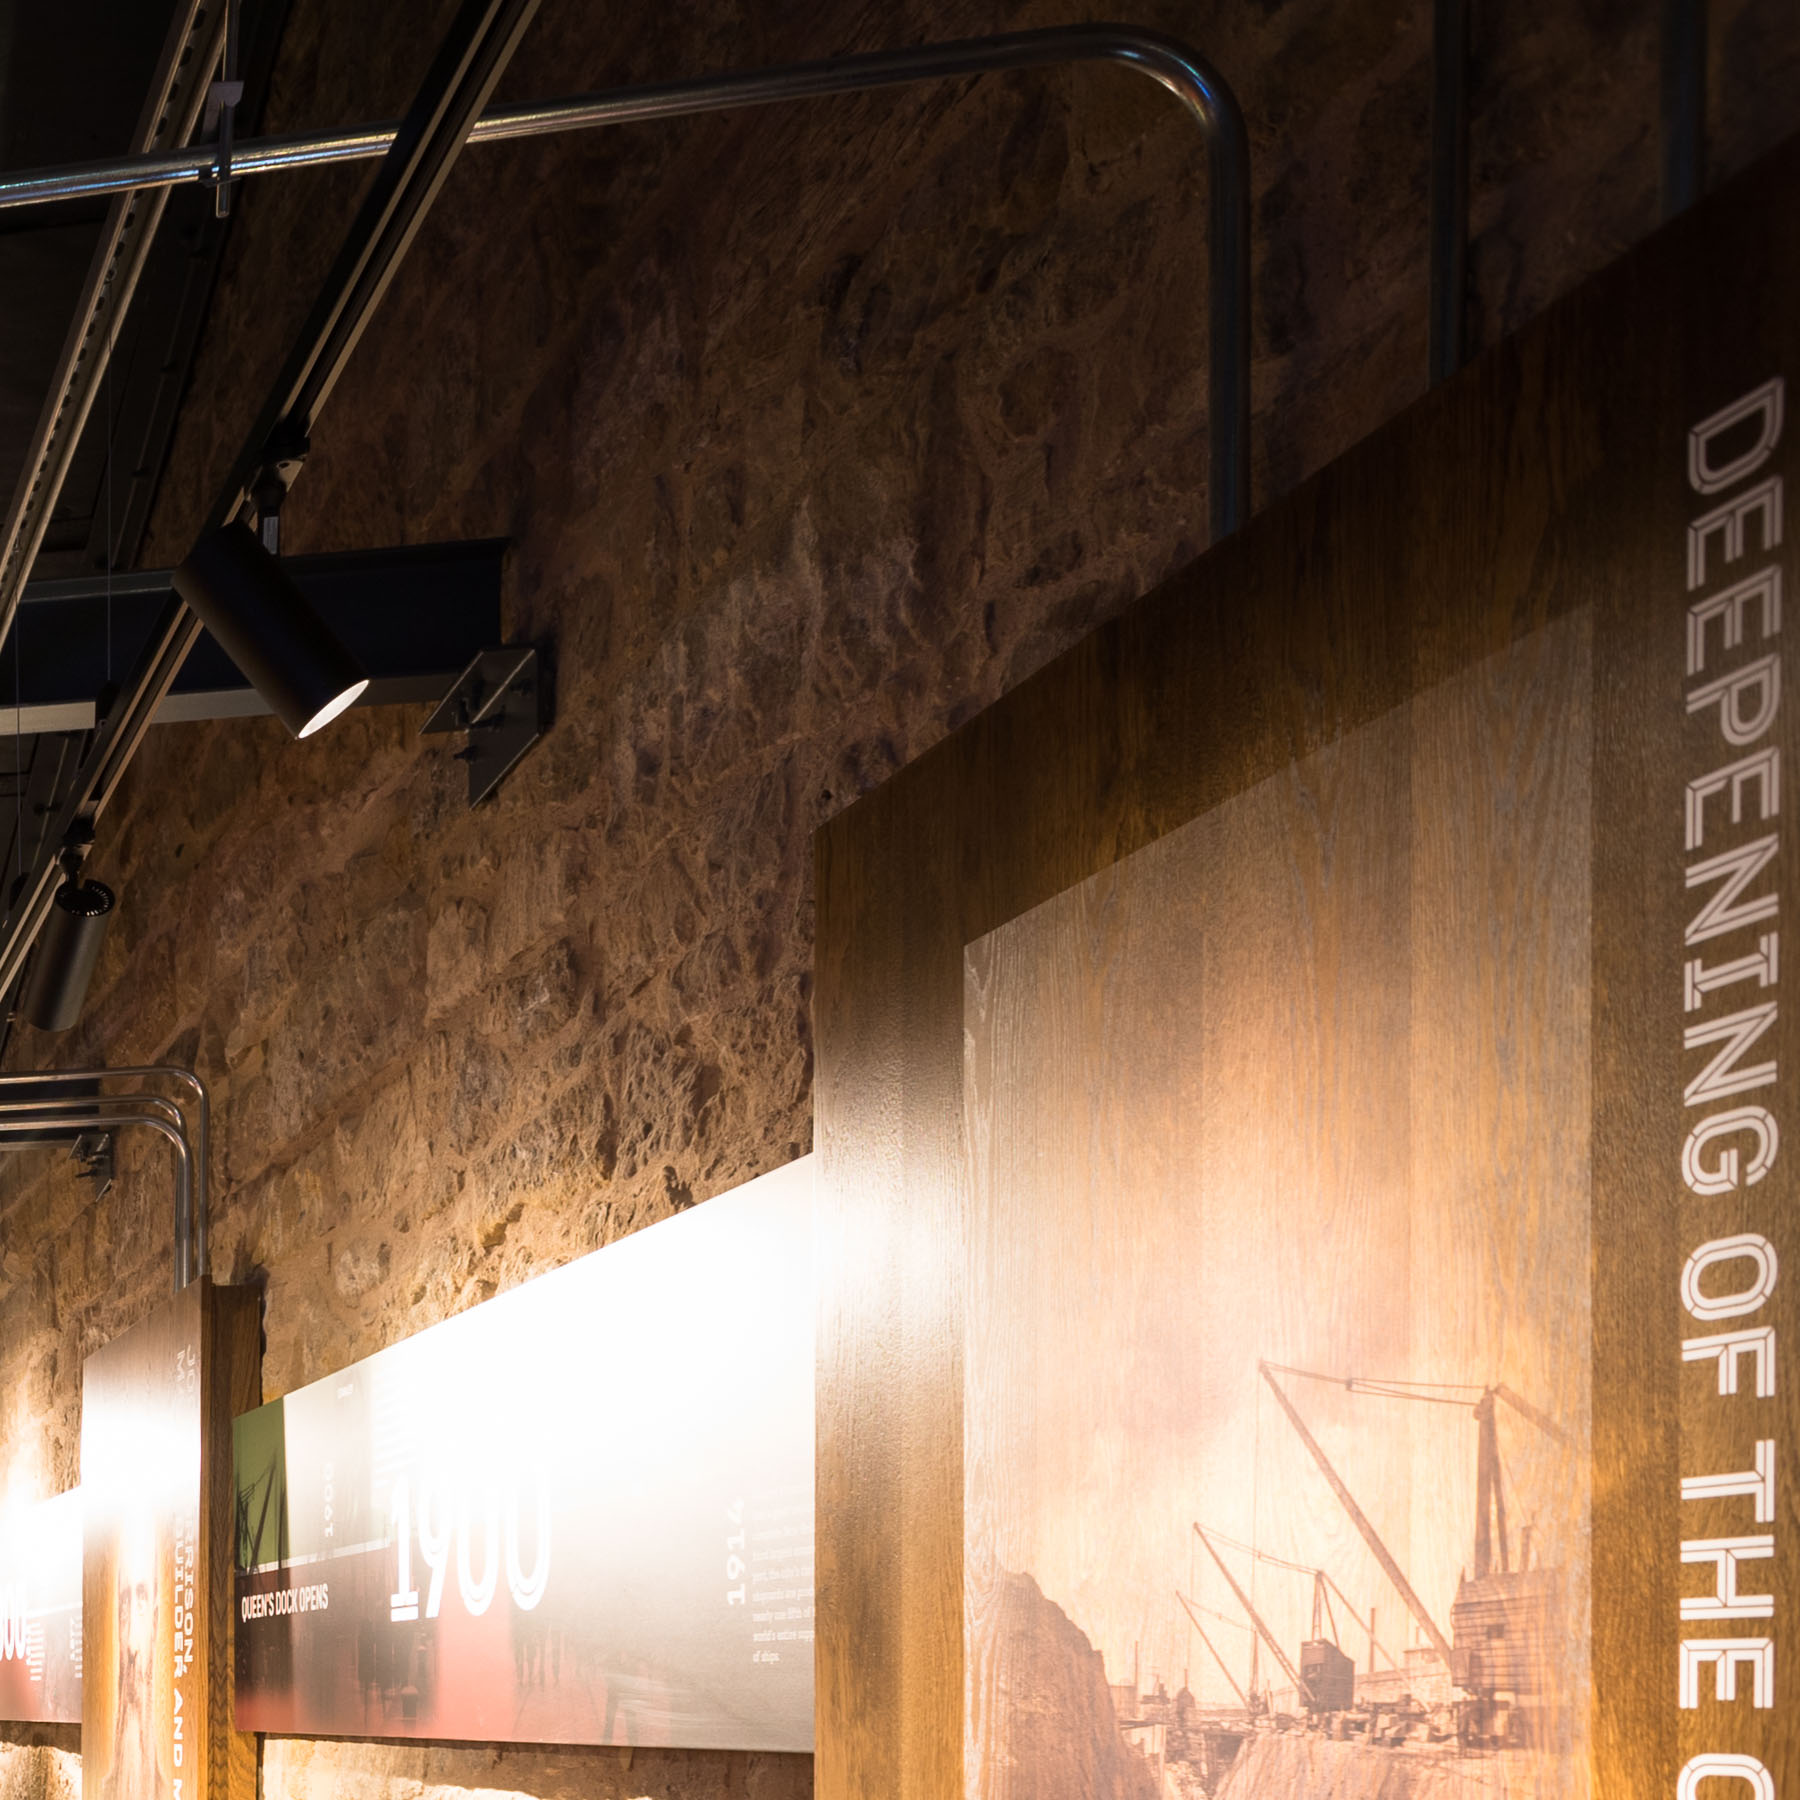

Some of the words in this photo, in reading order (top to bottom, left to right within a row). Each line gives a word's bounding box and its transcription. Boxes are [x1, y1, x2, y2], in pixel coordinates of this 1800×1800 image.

[1682, 375, 1783, 1197] DEEPENING
[1679, 1237, 1777, 1398] OF
[242, 1592, 274, 1622] QUEEN'S
[276, 1588, 298, 1615] DOCK
[300, 1583, 328, 1612] OPENS
[390, 1445, 554, 1623] 1900
[727, 1497, 746, 1606] 1914
[1679, 1443, 1775, 1713] THE
[173, 1688, 184, 1768] AND
